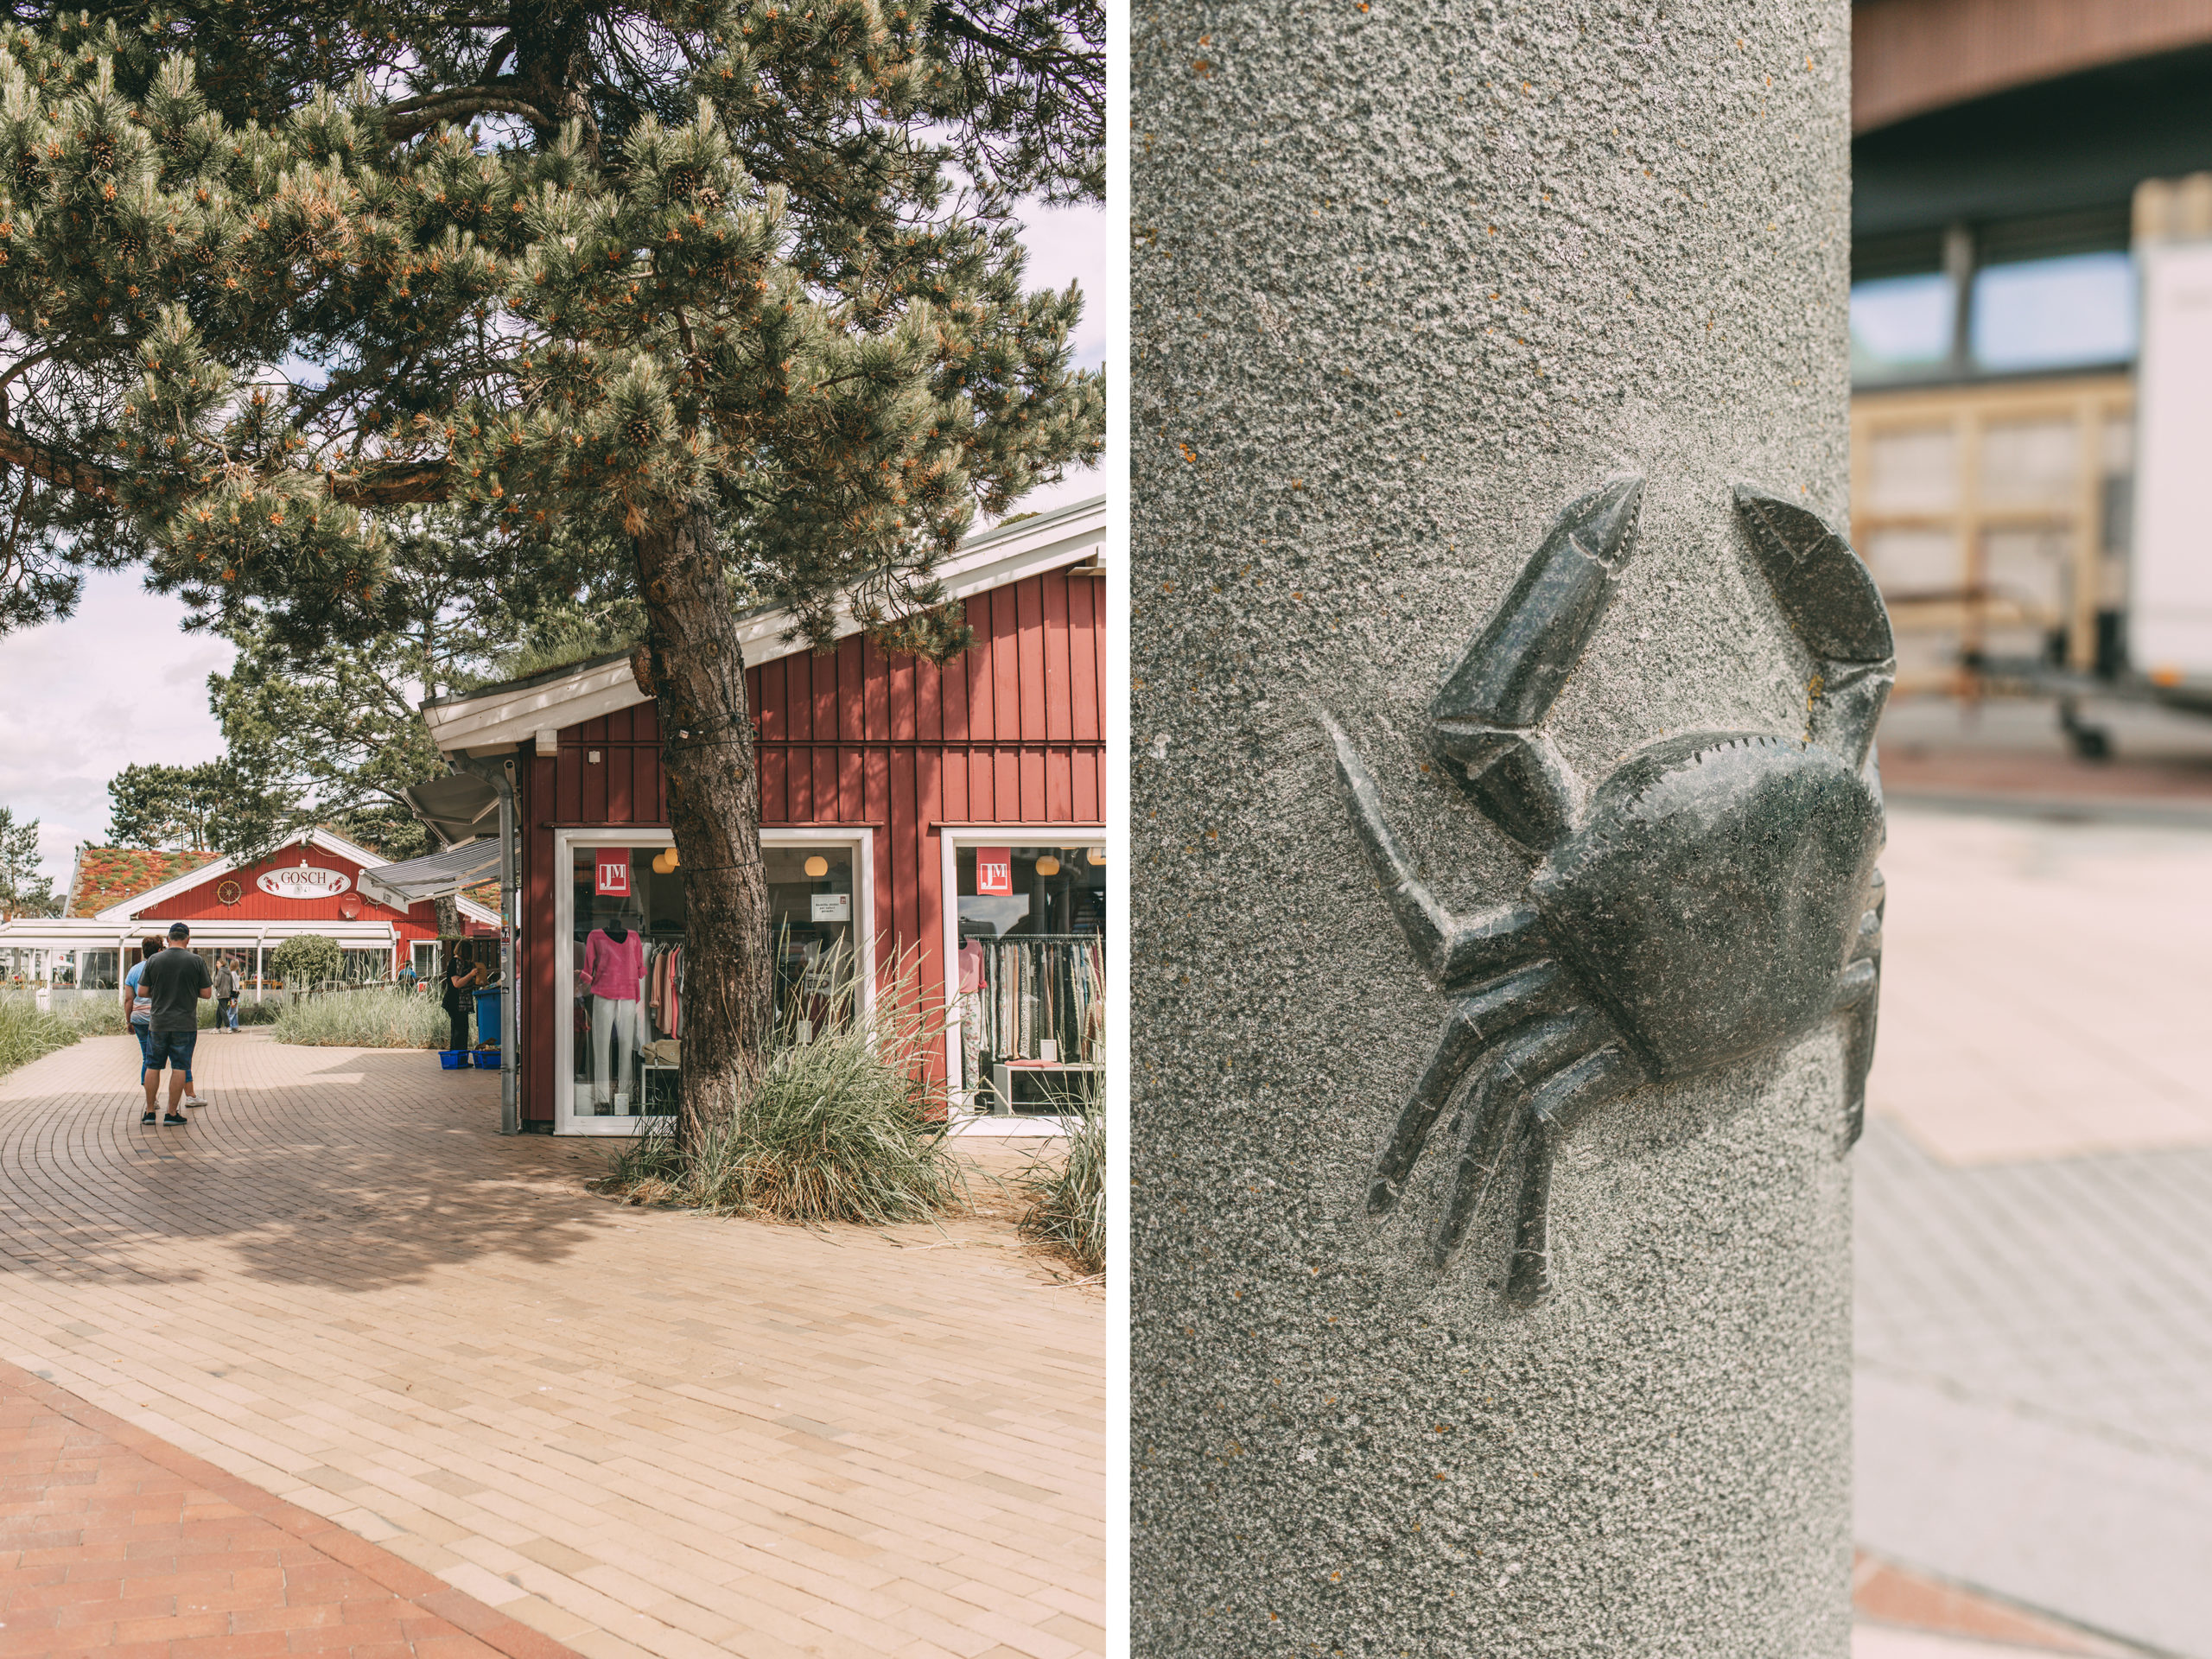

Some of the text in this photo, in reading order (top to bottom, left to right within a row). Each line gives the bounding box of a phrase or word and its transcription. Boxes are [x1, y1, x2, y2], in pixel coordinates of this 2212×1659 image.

[281, 871, 326, 884] GOSCH
[600, 864, 625, 888] JM
[981, 863, 1007, 887] JM
